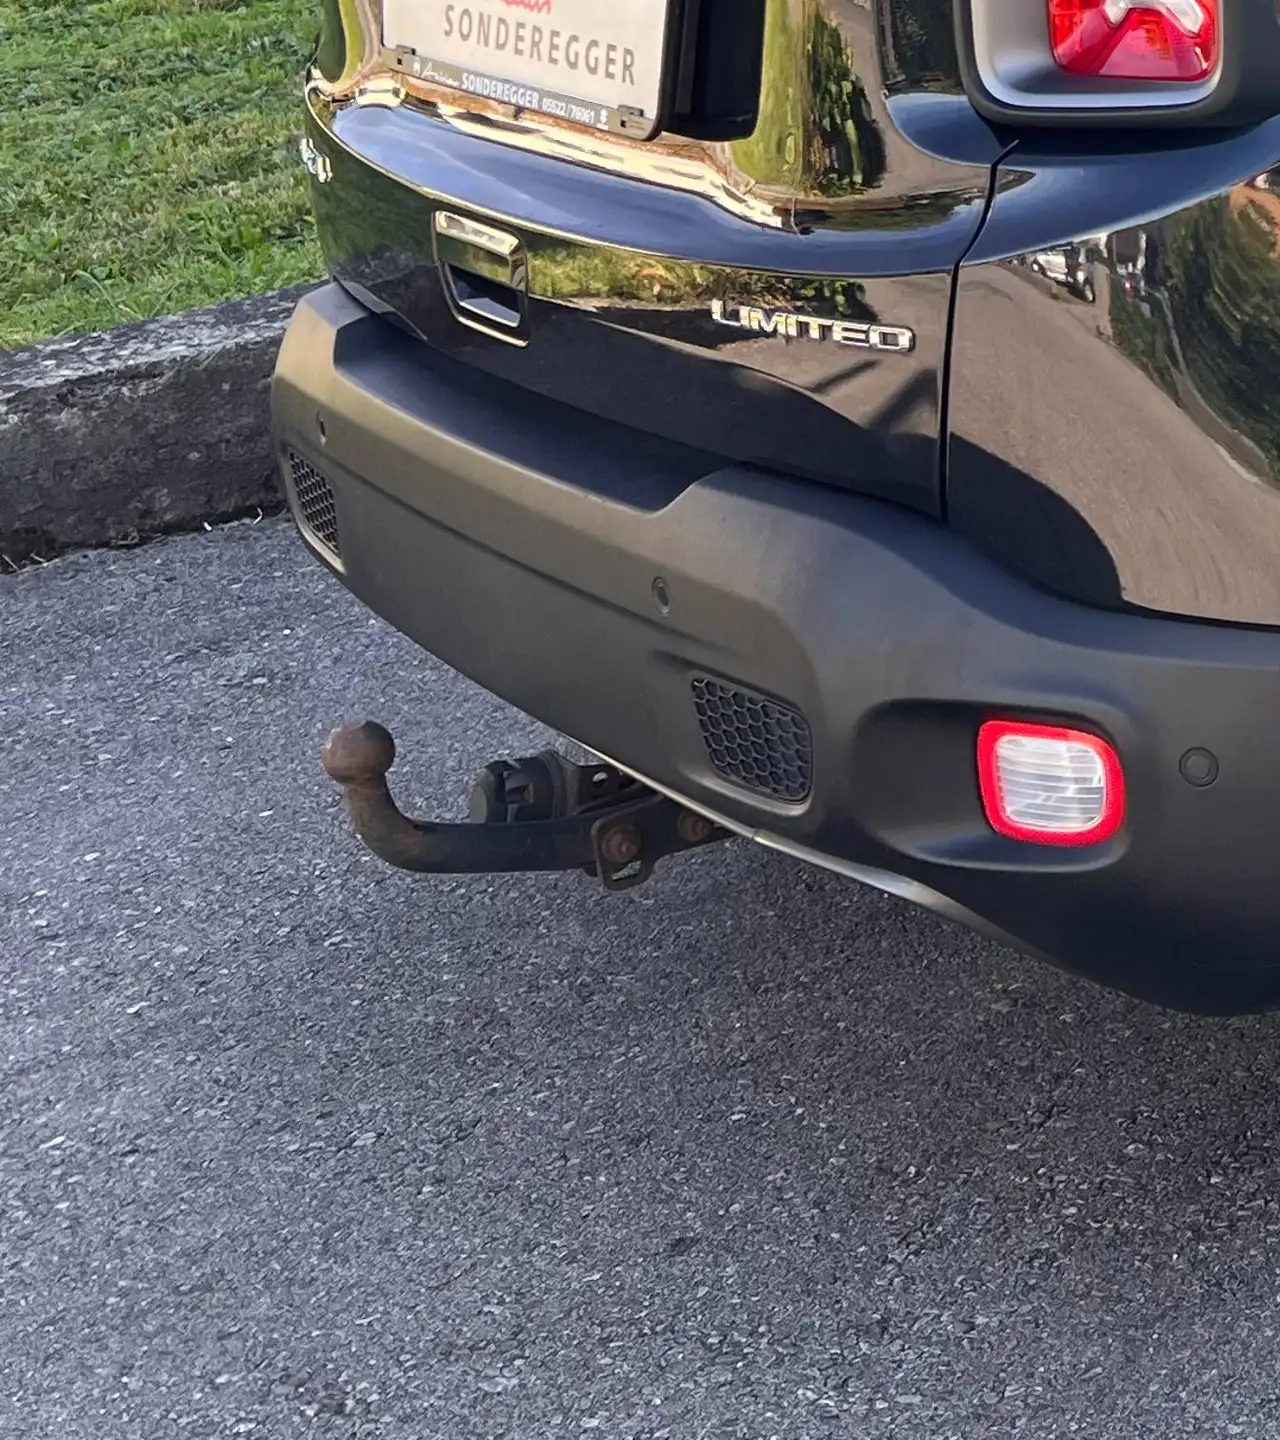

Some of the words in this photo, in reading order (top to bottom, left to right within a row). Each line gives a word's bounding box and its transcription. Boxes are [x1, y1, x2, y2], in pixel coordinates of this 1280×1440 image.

[444, 4, 636, 86] SONDEREGGER
[462, 72, 540, 109] SONDEREGGER
[711, 298, 914, 353] LIMITED
